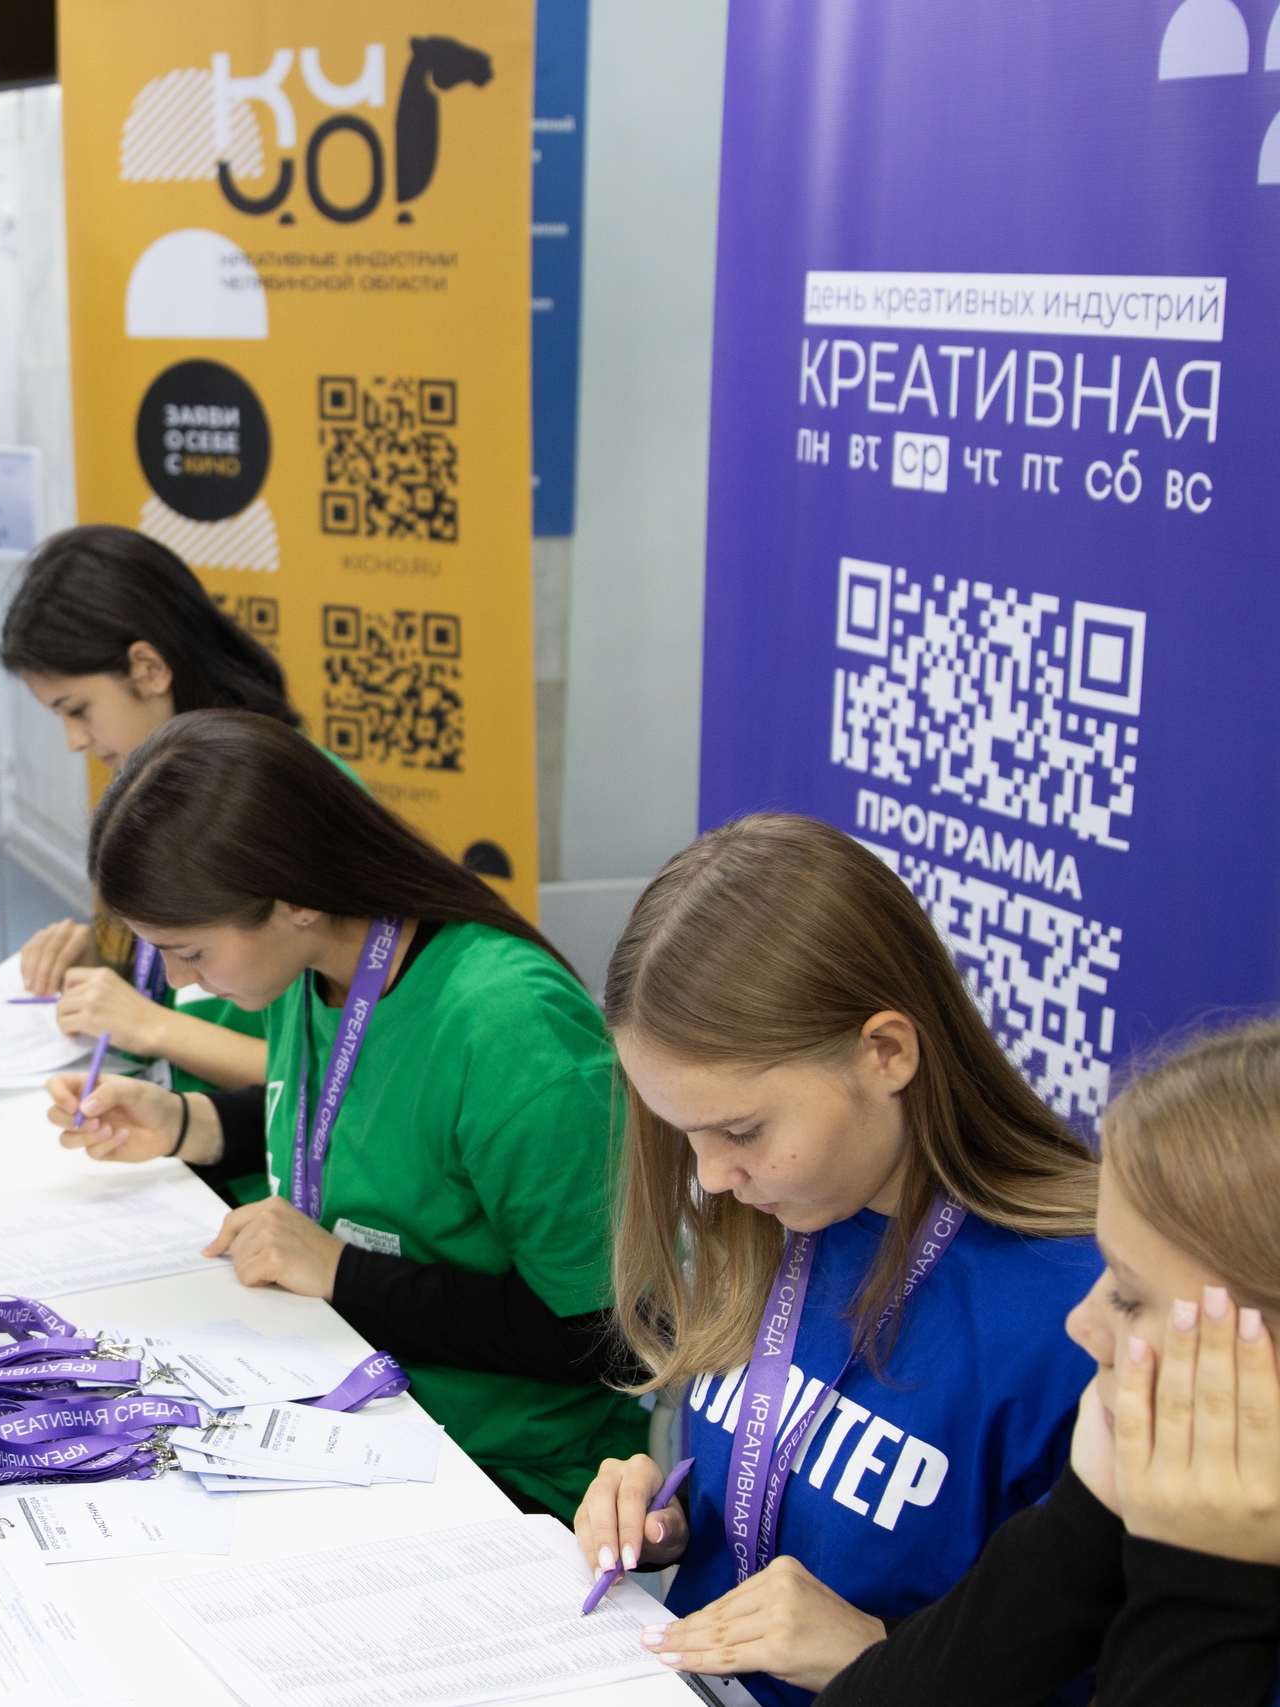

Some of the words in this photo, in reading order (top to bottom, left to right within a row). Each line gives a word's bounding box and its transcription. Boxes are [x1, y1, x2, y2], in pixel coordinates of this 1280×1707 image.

[809, 284, 868, 314] день
[873, 286, 1034, 320] креативных
[1043, 284, 1219, 331] индустрий
[799, 338, 1221, 443] КРЕАТИВНАЯ
[163, 404, 241, 429] ЗАЯВИ
[163, 429, 183, 452] О
[184, 431, 241, 454] СЕБЕ
[164, 453, 183, 476] С
[797, 428, 830, 464] пн
[849, 433, 882, 471] вт
[899, 439, 944, 488] ср
[963, 446, 1002, 486] чт
[1021, 453, 1063, 494] пт
[1085, 449, 1142, 503] сб
[1165, 469, 1214, 514] вс
[856, 788, 1083, 900] ПРОГРАММА
[325, 997, 370, 1106] КРЕАТИВНАЯ
[313, 1108, 332, 1160] СРЕДА
[763, 1286, 795, 1356] СРЕДА
[114, 1401, 184, 1423] СРЕДА
[325, 1424, 342, 1454] УЧАСТНИК
[778, 1409, 816, 1471] СРЕДА
[733, 1392, 772, 1537] КРЕАТИВНАЯ
[29, 1496, 44, 1516] СРЕДА
[84, 1501, 113, 1539] УЧАСТНИК
[37, 1515, 61, 1550] КРЕАТИВНАЯ
